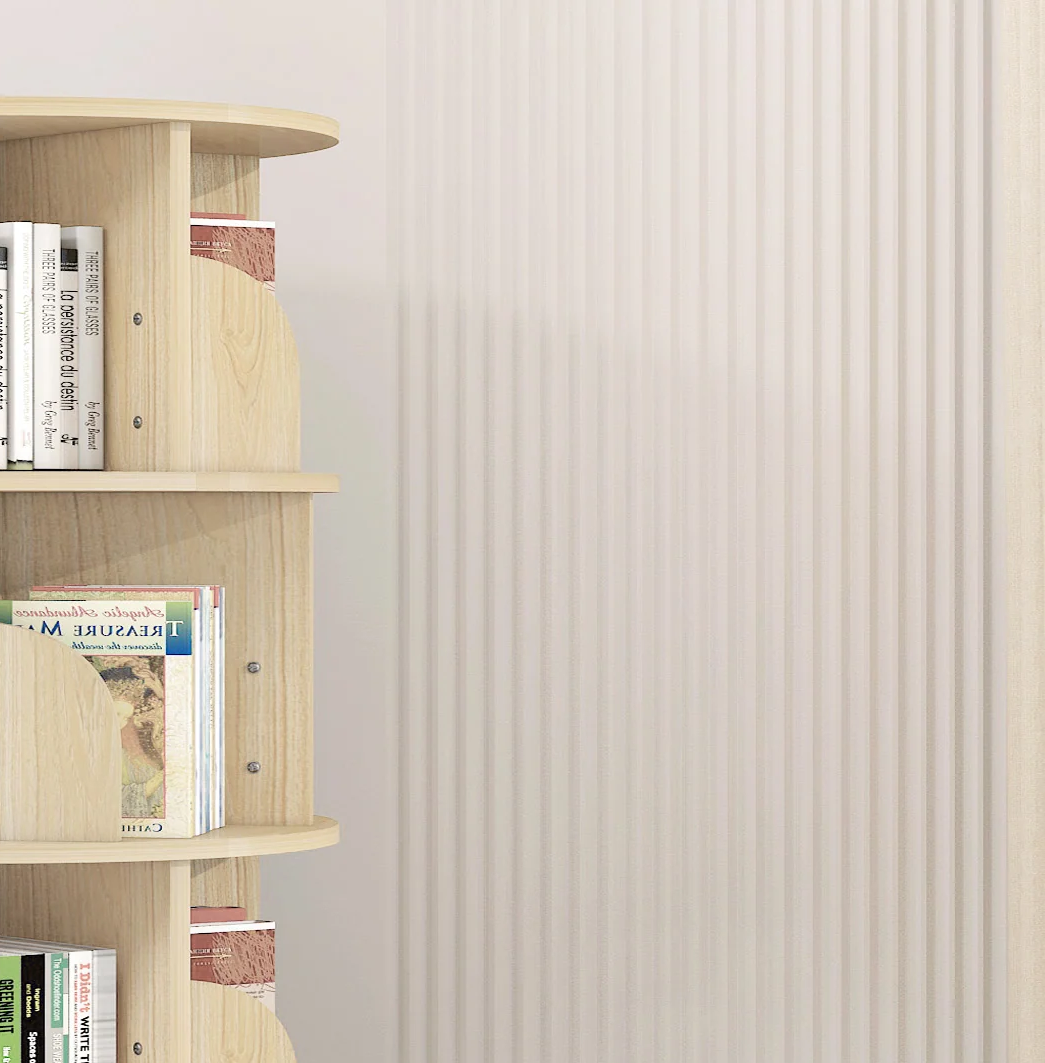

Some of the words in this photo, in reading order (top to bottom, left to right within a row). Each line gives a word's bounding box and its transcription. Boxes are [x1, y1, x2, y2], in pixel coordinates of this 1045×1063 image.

[43, 250, 56, 270] THREE
[86, 252, 99, 272] THREE
[43, 272, 56, 292] PAIRS
[86, 275, 99, 294] PAIRS
[43, 294, 56, 303] OF
[61, 291, 78, 301] La
[86, 296, 99, 305] OF
[43, 305, 56, 334] GLASSES
[86, 307, 99, 336] GLASSES
[61, 305, 78, 362] persistance
[61, 366, 78, 379] du
[43, 401, 58, 409] by
[61, 382, 78, 411] destin
[86, 402, 100, 410] by
[43, 411, 58, 427] Greg
[86, 411, 100, 427] Greg
[43, 428, 58, 450] Bennet
[86, 428, 100, 450] Bennet
[0, 979, 15, 1023] GREENING
[80, 972, 91, 1013] Didn't
[0, 1025, 15, 1034] IT
[80, 1016, 91, 1051] WRITE
[27, 1031, 38, 1058] Spaces
